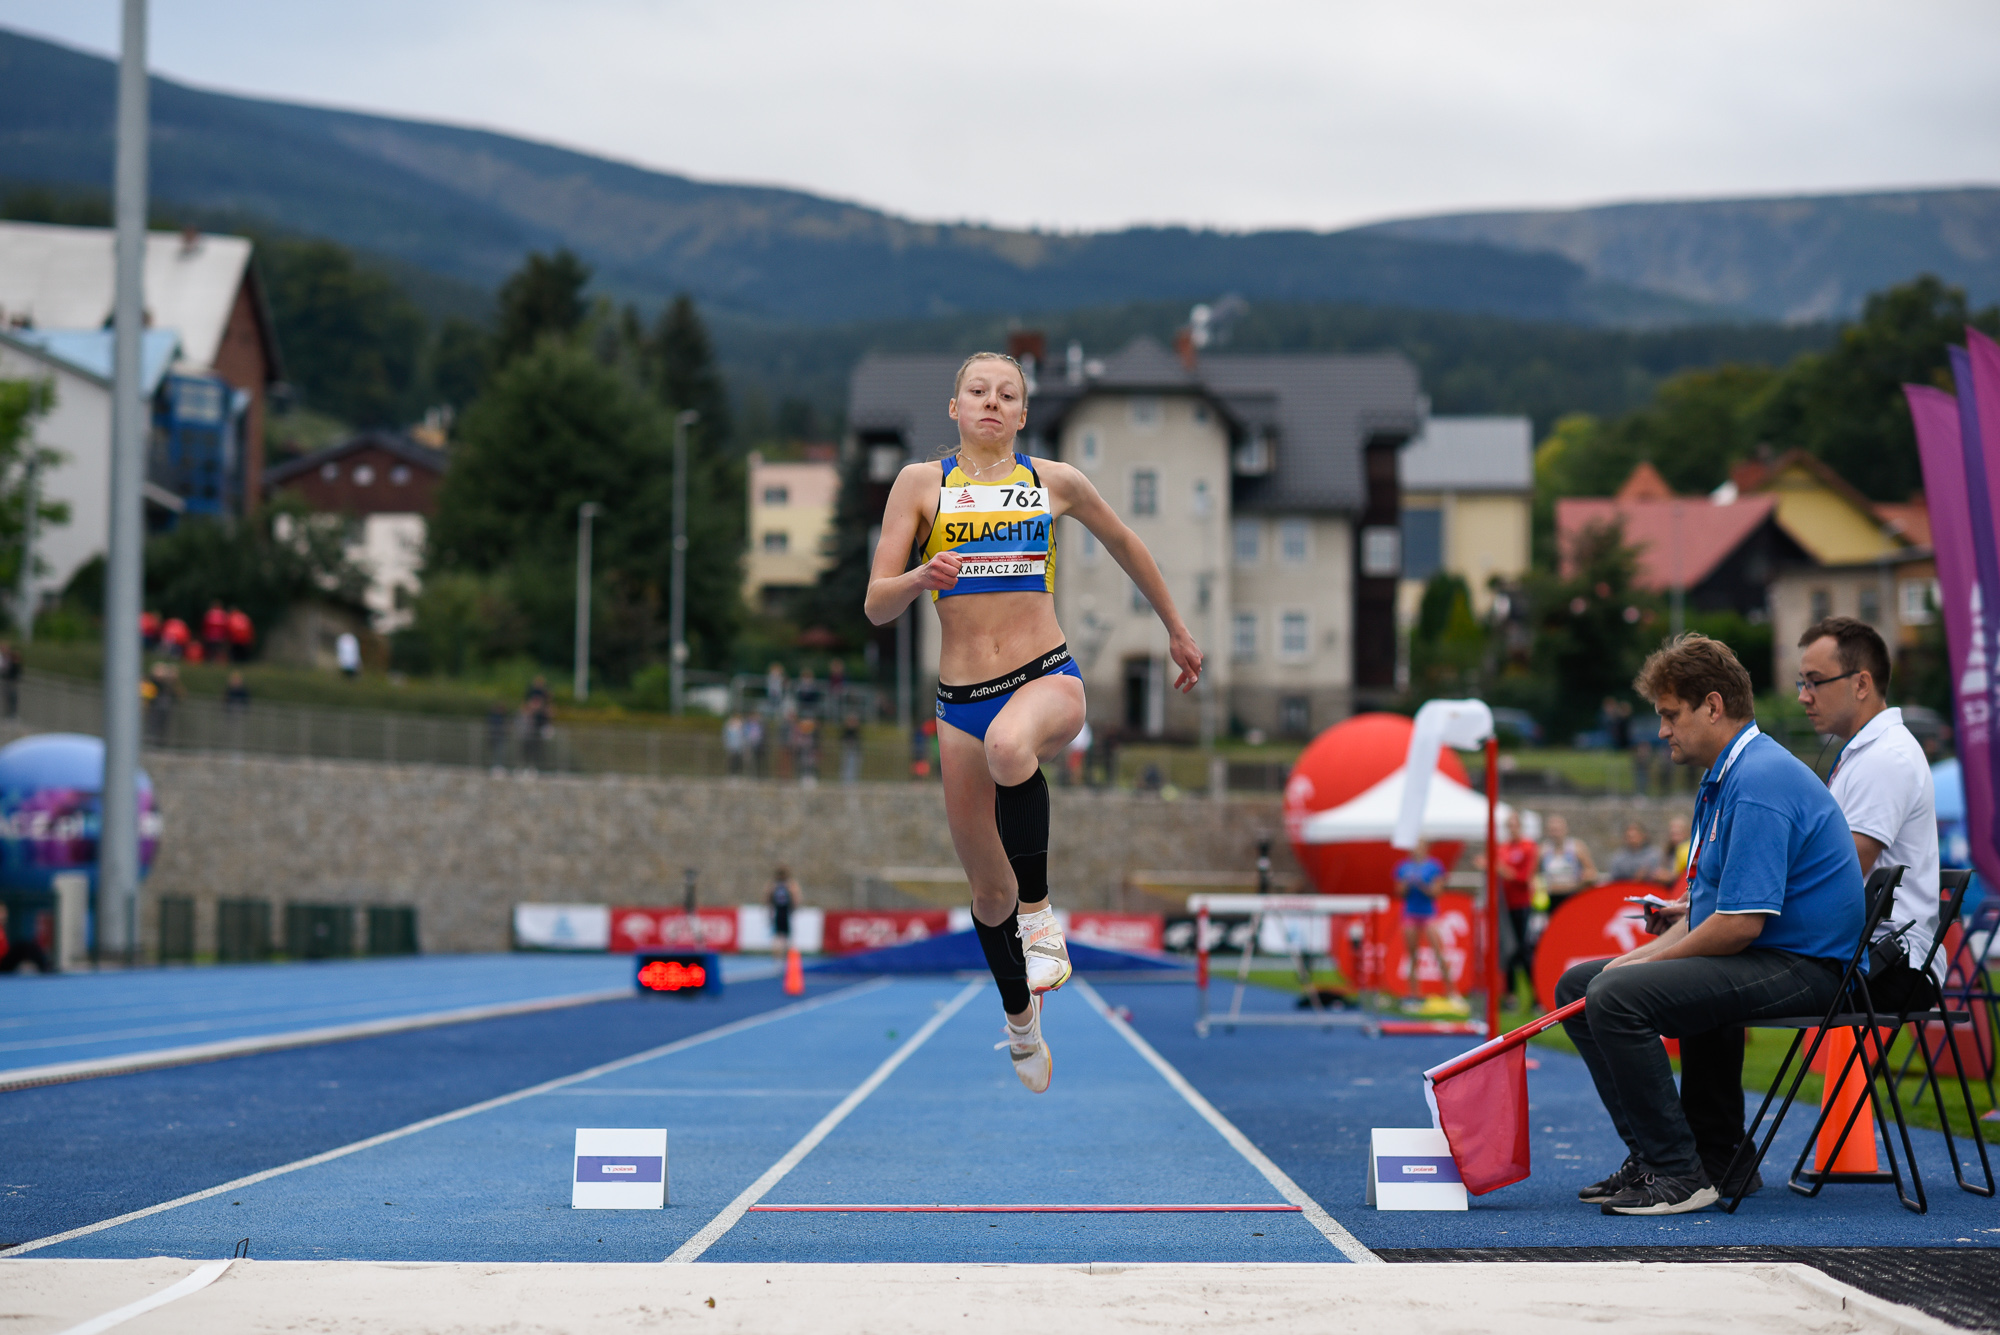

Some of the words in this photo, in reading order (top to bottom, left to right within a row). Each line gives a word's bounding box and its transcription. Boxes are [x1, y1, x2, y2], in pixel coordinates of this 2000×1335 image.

[1000, 489, 1043, 508] 762
[945, 521, 1045, 543] SZLACHTA
[958, 564, 1010, 575] KARPACZ
[1012, 563, 1032, 573] 2021
[970, 673, 1027, 698] AdRunaLine
[1030, 926, 1050, 944] NIKE
